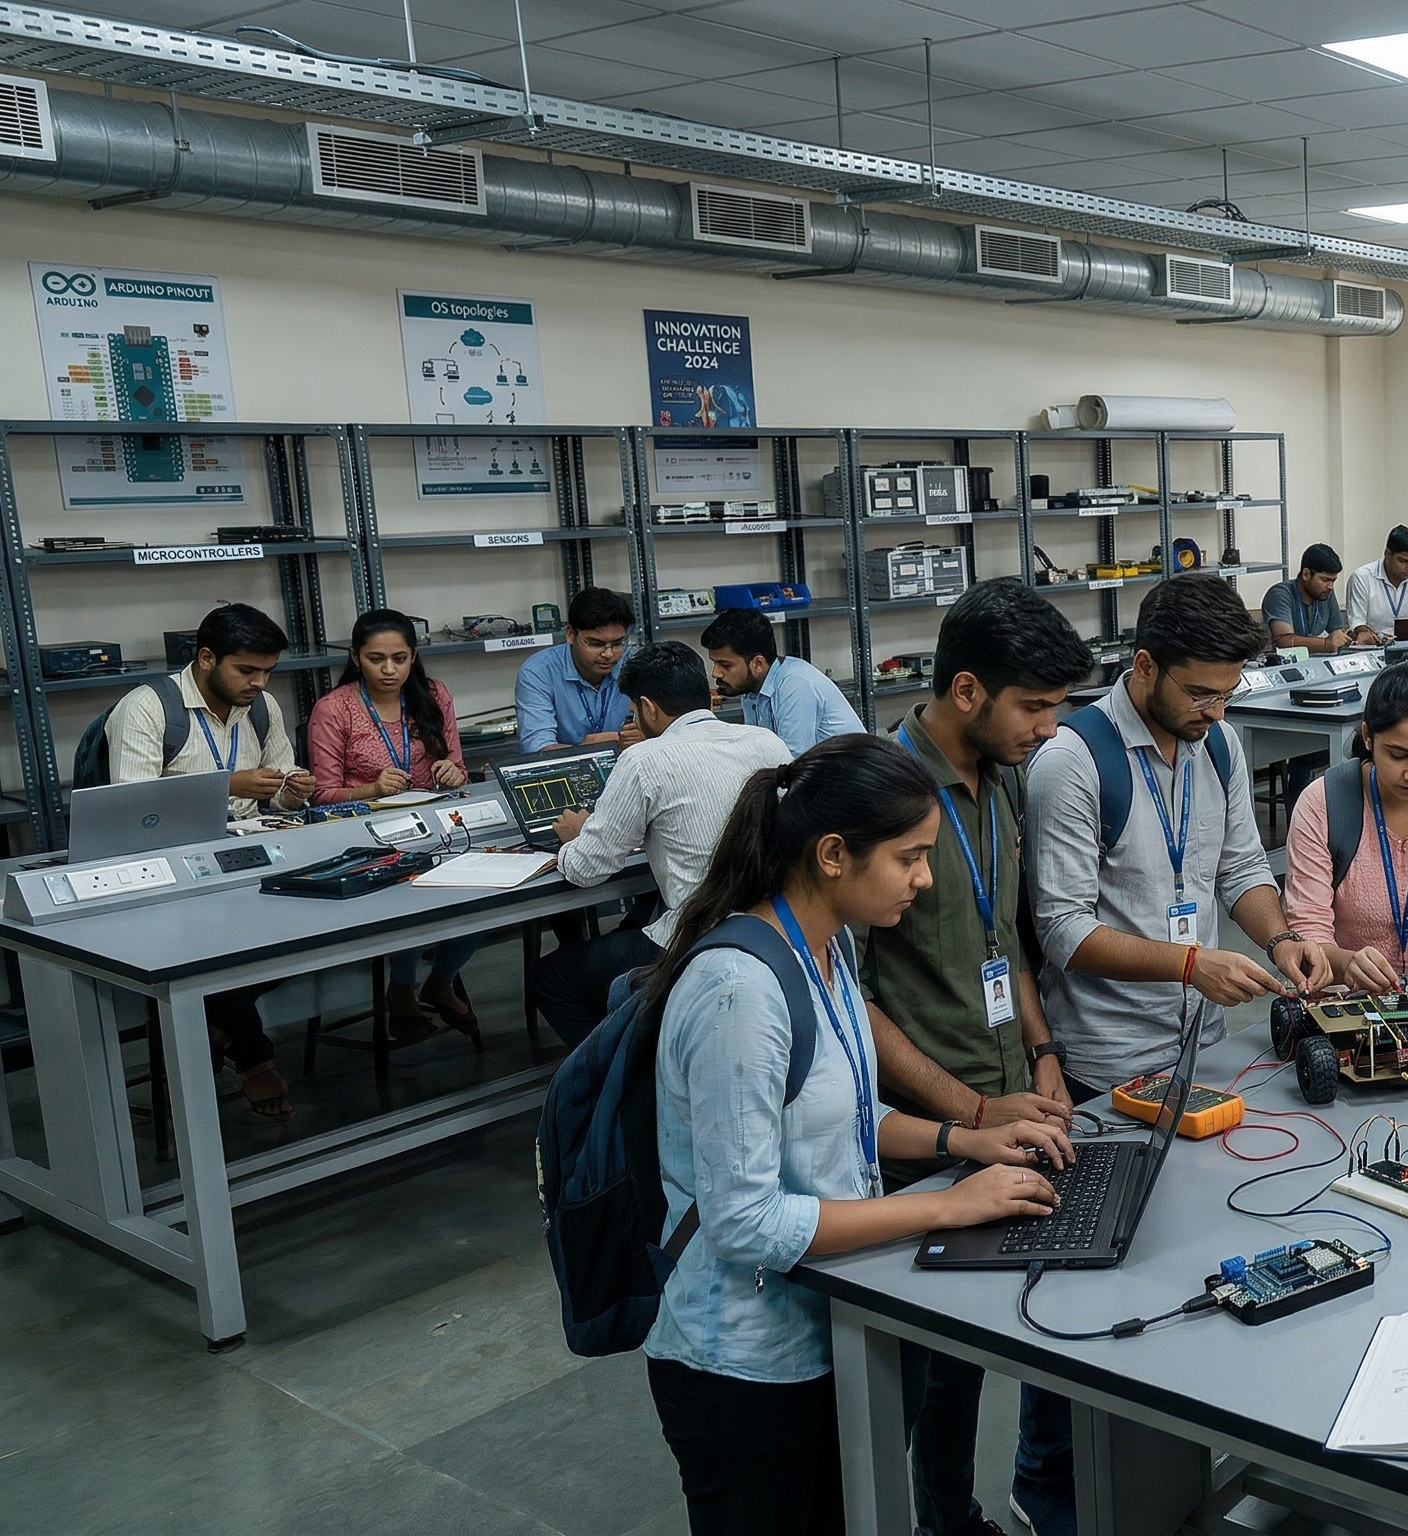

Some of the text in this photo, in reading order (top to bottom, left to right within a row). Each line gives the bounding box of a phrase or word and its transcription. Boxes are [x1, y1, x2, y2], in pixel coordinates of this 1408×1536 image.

[108, 282, 210, 299] ARDUINO PINOUT
[46, 297, 99, 308] ARDUINO
[431, 301, 449, 314] OS
[654, 320, 741, 339] INNOVATION
[657, 338, 740, 355] CHALLENGE
[684, 355, 718, 369] 2024
[138, 546, 261, 561] MICROCONTROLLERS
